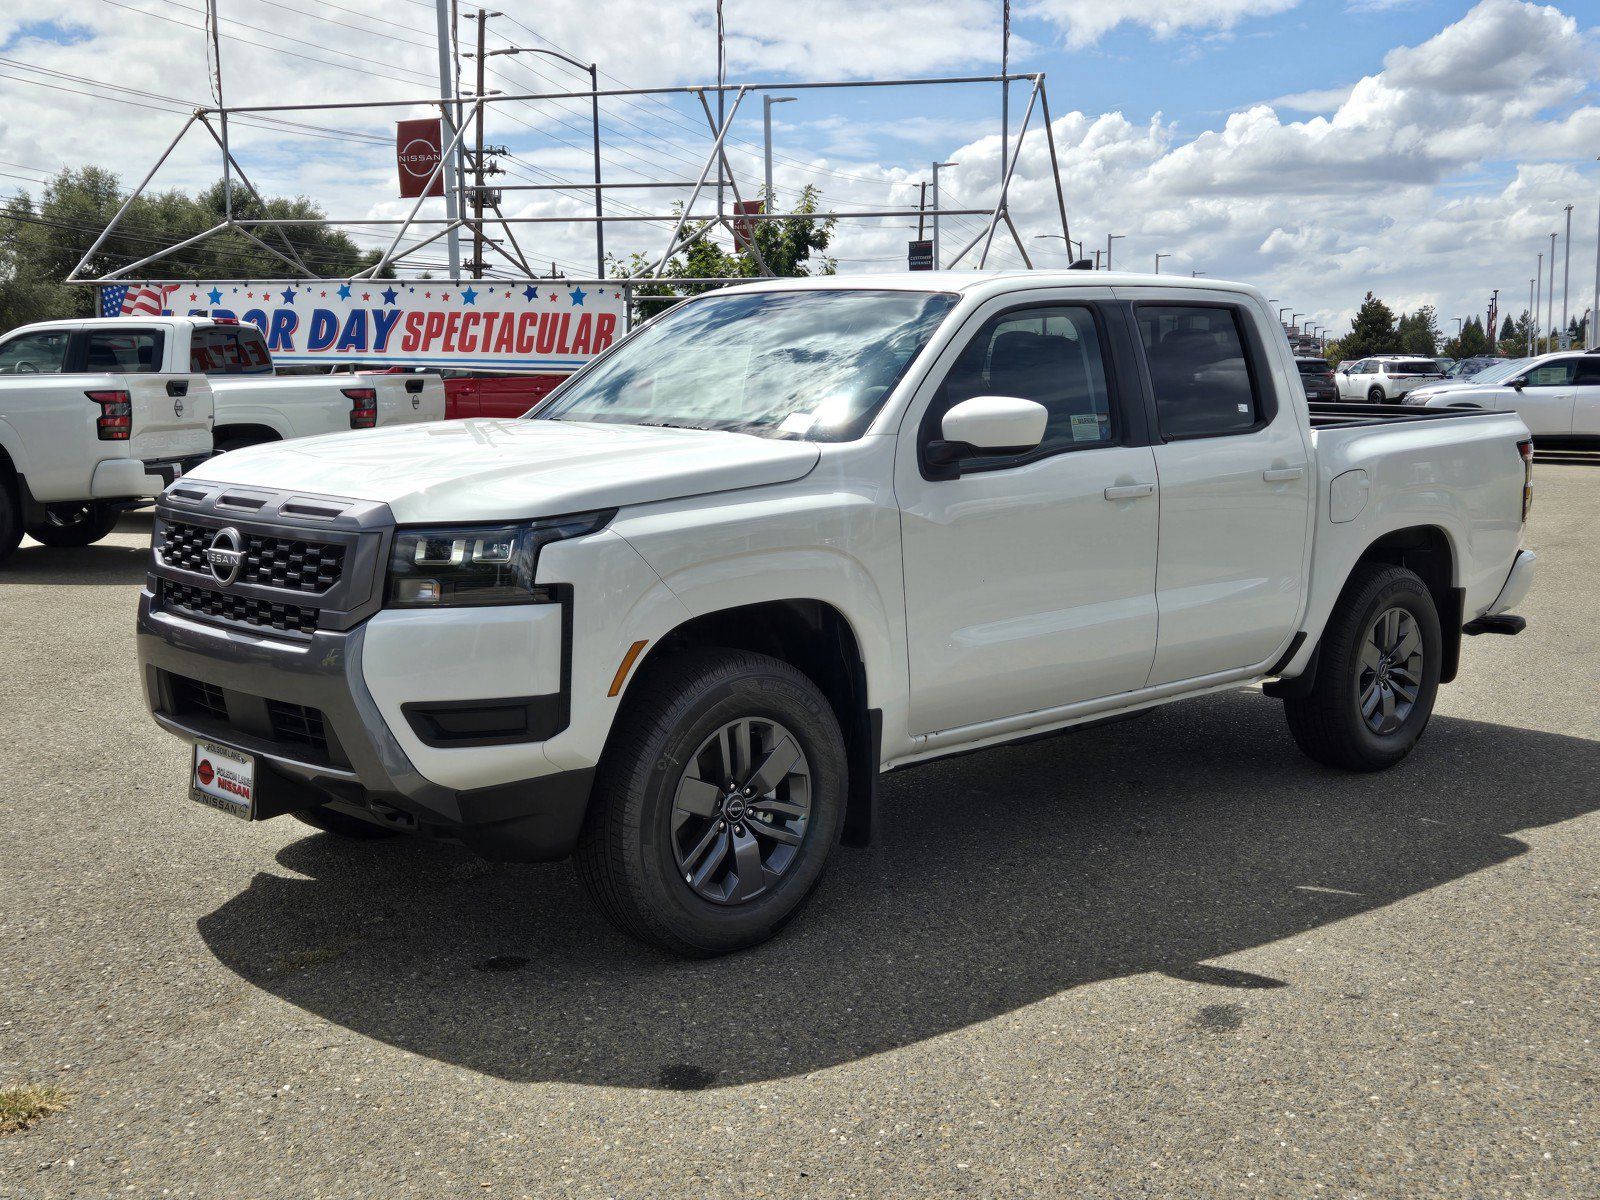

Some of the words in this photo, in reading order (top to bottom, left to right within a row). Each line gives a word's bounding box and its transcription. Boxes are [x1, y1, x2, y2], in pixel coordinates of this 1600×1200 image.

[398, 154, 441, 162] NISSAN
[307, 309, 404, 353] DAY
[401, 311, 617, 355] SPECTACULAR
[218, 777, 249, 799] NISSAN
[203, 795, 237, 813] NISSAN
